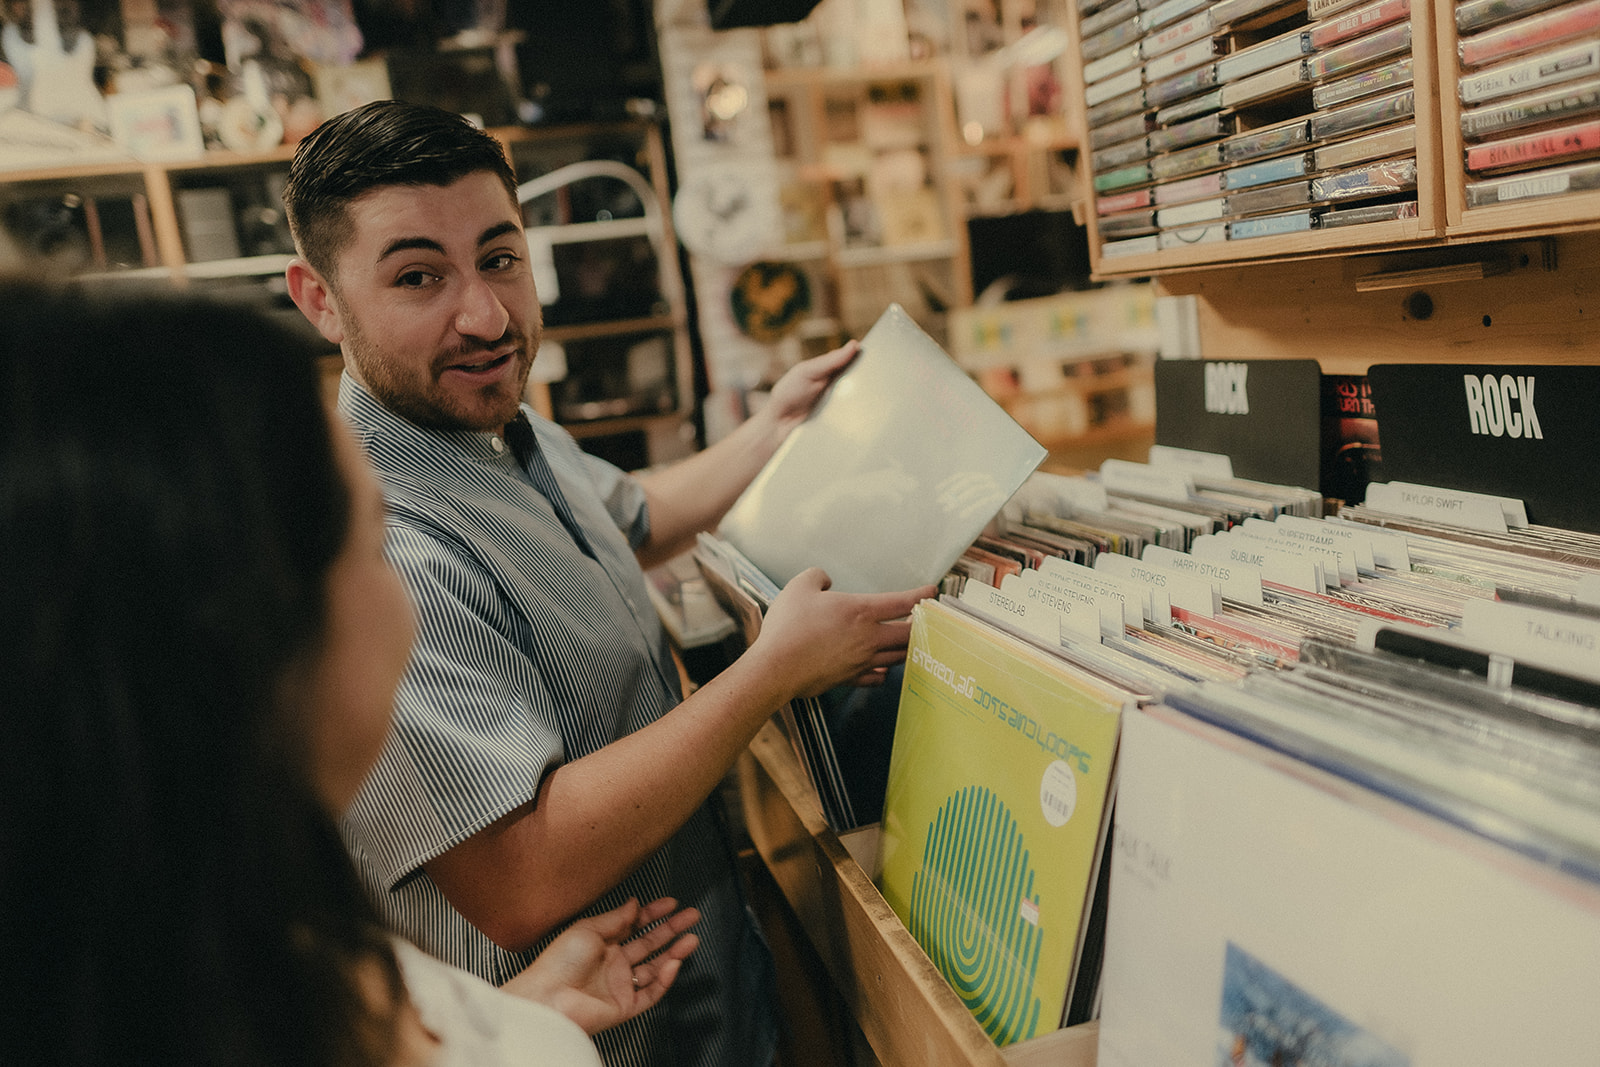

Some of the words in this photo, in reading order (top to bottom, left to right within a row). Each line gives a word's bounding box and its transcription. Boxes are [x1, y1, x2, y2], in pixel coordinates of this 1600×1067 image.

[1205, 362, 1249, 415] ROCK
[1463, 373, 1544, 440] ROCK
[1401, 492, 1434, 507] TAYLOR
[1435, 496, 1464, 511] SWIFT
[1278, 527, 1334, 546] SUPERTRAMP
[1172, 557, 1200, 573] HARRY
[1199, 562, 1231, 581] STYLES
[1230, 549, 1265, 567] SUBLIME
[1130, 567, 1167, 588] STROKES
[988, 591, 1027, 617] STEREOLAB
[1027, 586, 1042, 600] CAT
[1041, 592, 1073, 615] STEVENS
[1526, 621, 1595, 651] TALKING
